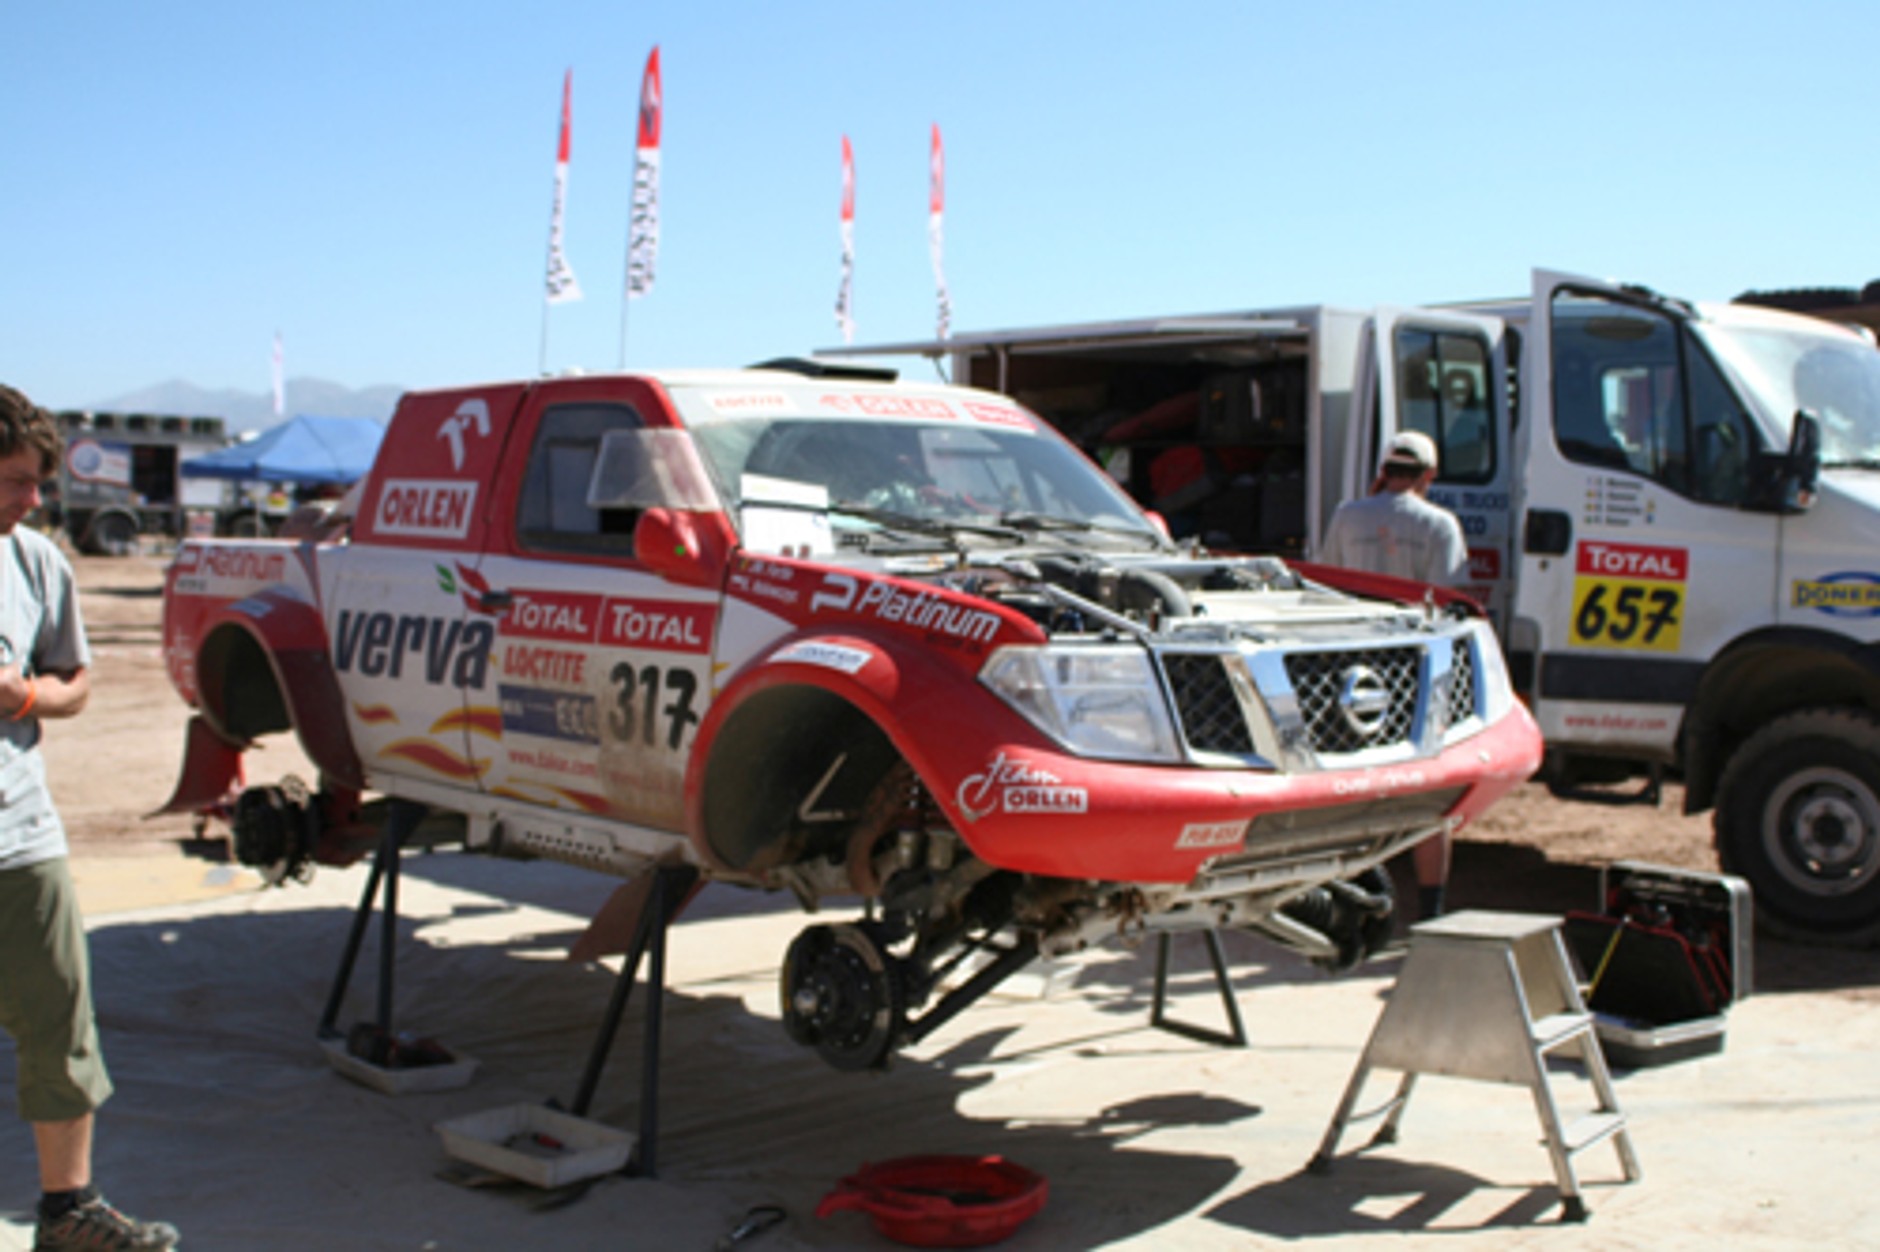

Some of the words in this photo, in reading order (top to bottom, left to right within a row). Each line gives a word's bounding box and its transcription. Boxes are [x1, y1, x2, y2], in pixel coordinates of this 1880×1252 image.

[383, 487, 468, 530] ORLEN
[1585, 544, 1679, 577] TOTAL
[510, 596, 588, 634] TOTAL
[611, 603, 701, 645] TOTAL
[858, 580, 1001, 643] Platinum
[1575, 584, 1680, 643] 657
[335, 608, 495, 691] verva
[503, 644, 586, 684] LOCTITE
[609, 660, 697, 751] 317
[1008, 788, 1081, 806] ORLEN
